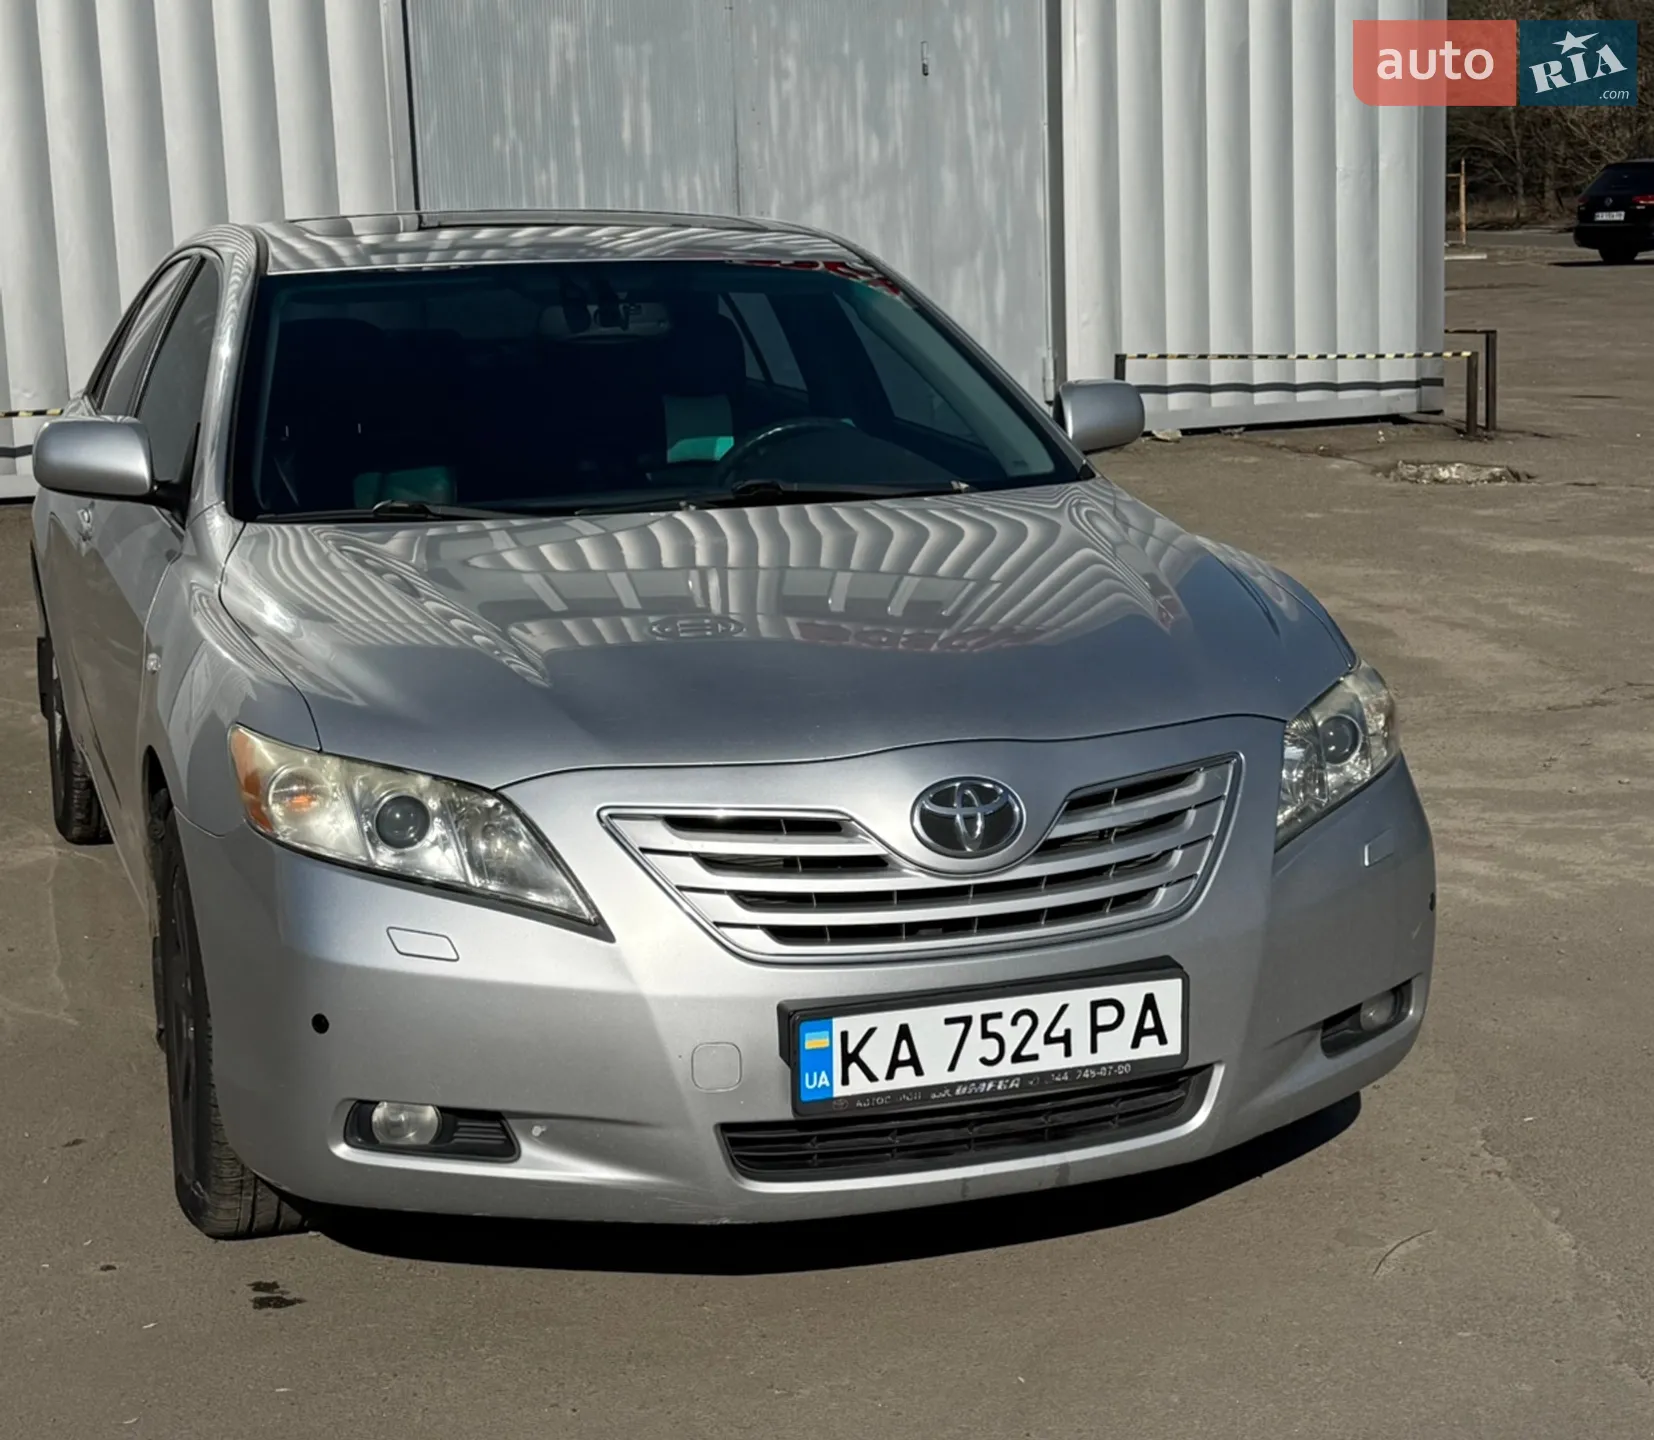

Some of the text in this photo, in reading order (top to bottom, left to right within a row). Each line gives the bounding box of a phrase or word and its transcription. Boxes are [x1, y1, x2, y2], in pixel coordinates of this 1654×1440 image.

[840, 992, 1169, 1087] KA 7524 PA
[805, 1072, 830, 1089] UA
